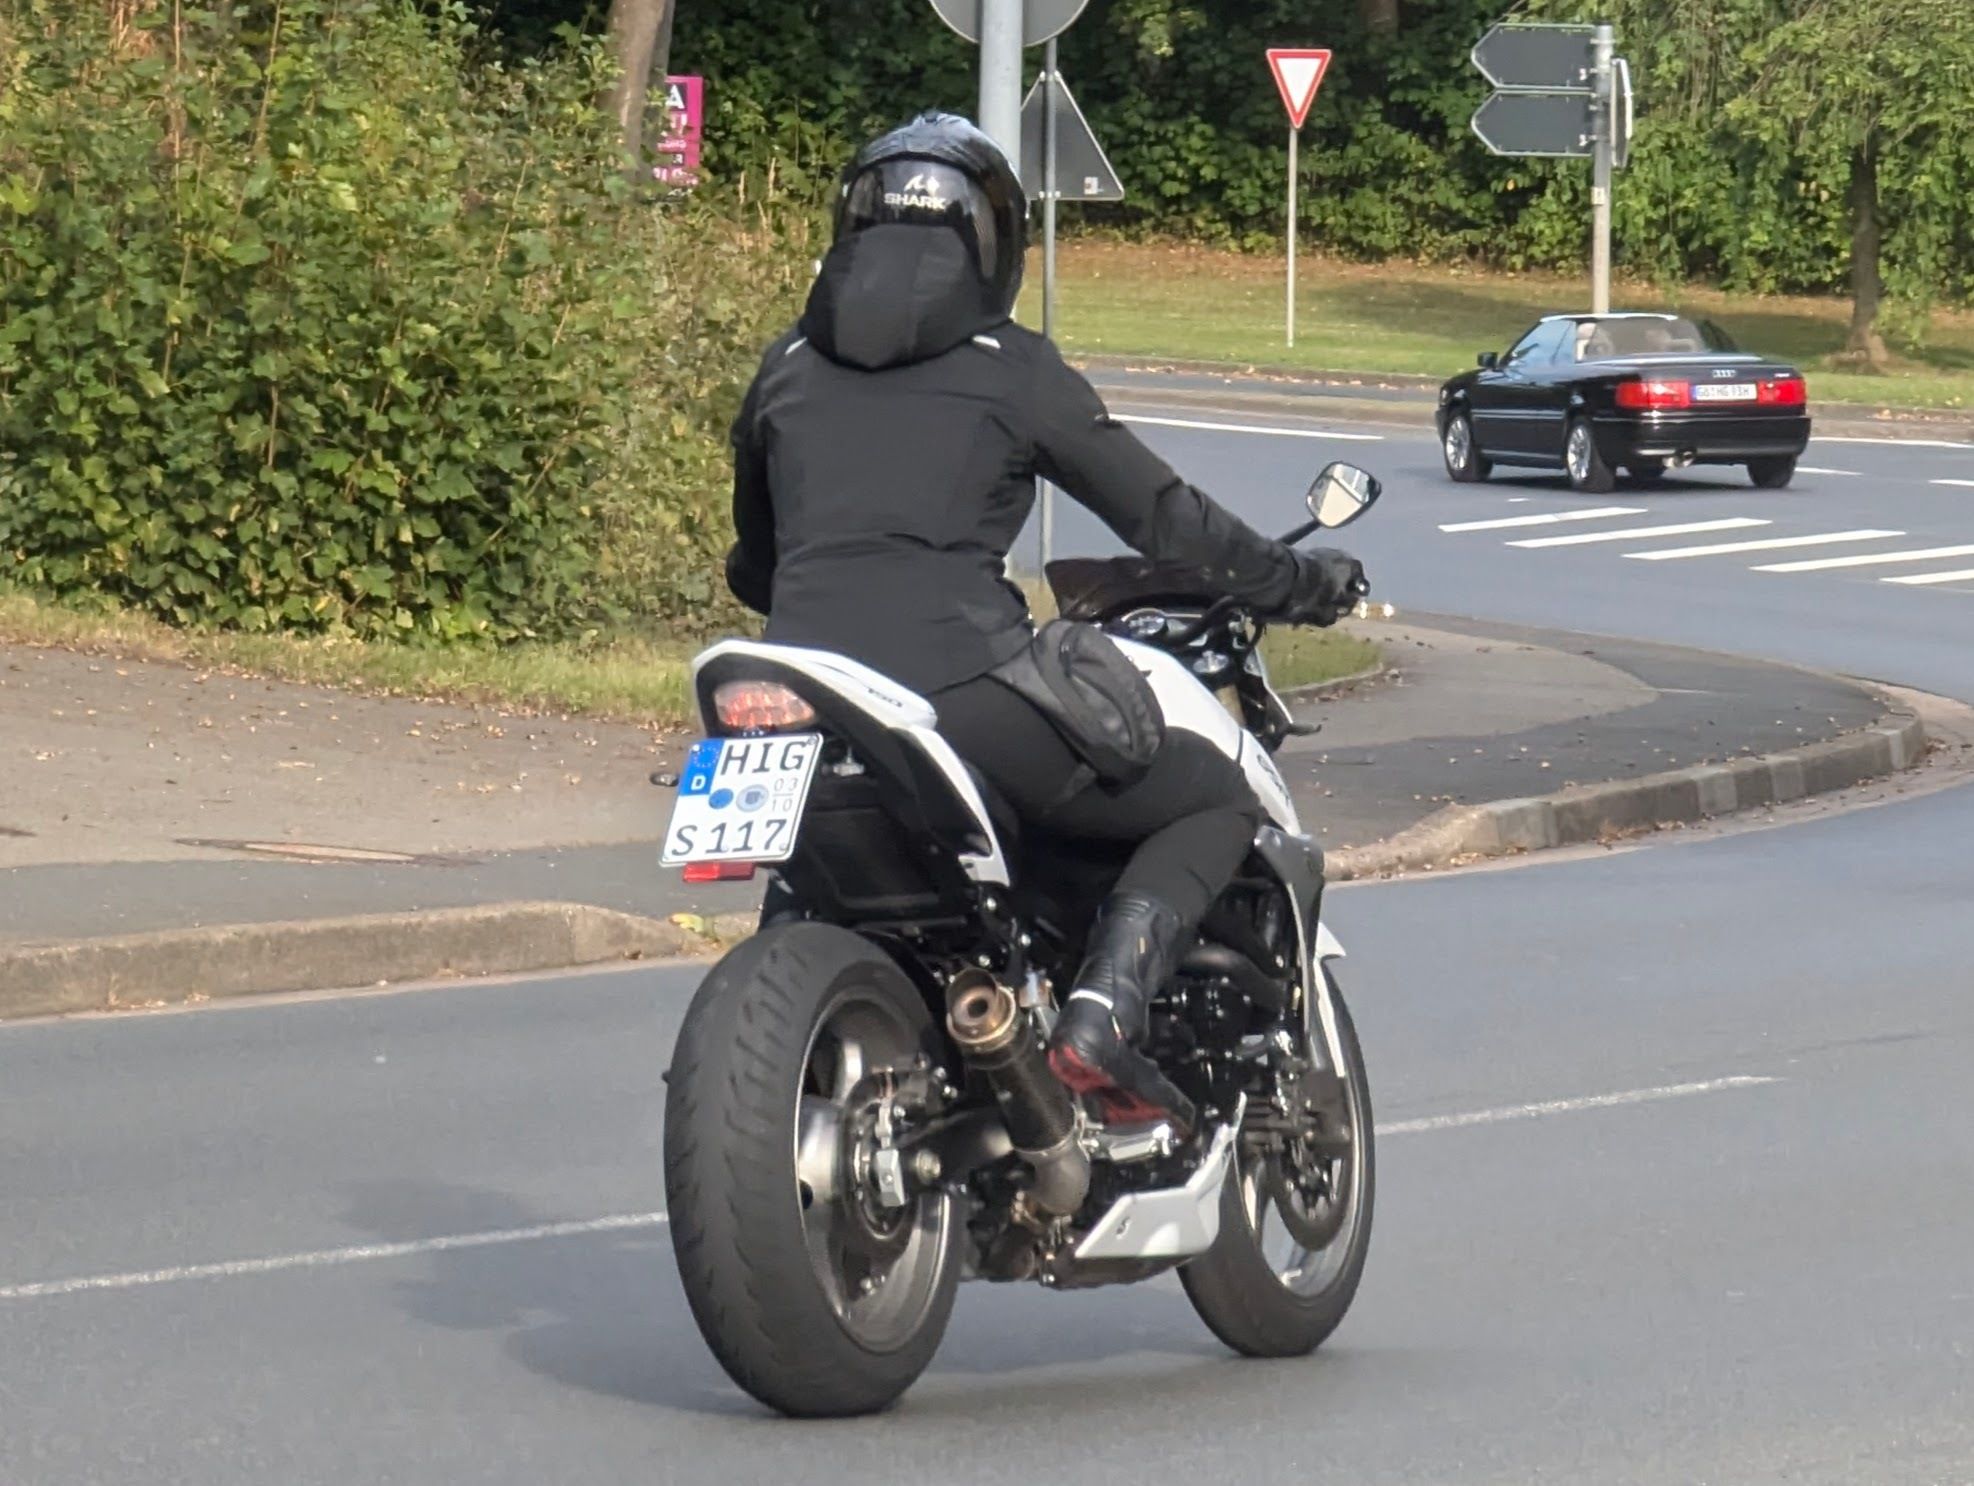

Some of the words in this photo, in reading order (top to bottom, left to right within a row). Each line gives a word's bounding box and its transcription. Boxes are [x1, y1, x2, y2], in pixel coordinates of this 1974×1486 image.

[883, 192, 948, 210] SHARK
[720, 740, 807, 776] HIG
[690, 775, 706, 791] D
[773, 777, 799, 792] 03
[671, 824, 698, 857] S
[705, 818, 788, 854] 117
